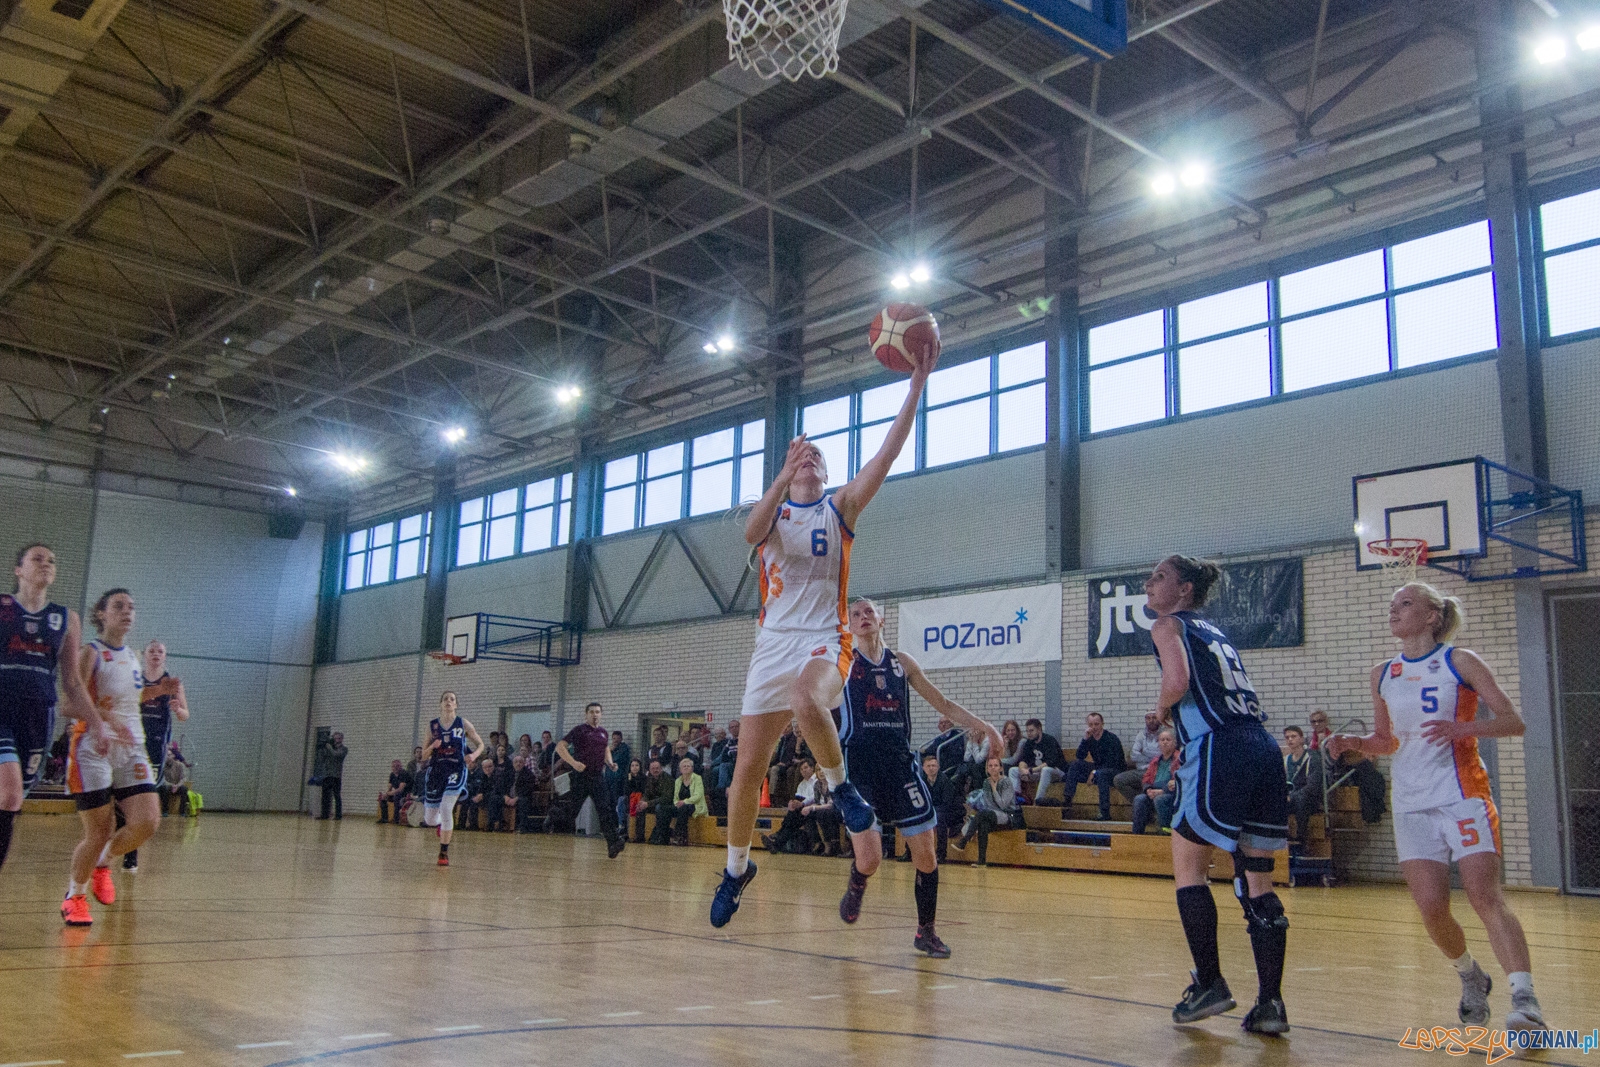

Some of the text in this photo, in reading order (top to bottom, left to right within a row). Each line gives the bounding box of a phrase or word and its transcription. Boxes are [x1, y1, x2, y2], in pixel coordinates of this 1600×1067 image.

[811, 529, 828, 557] 6
[48, 613, 63, 631] 9
[890, 658, 904, 678] 5
[1207, 640, 1256, 693] 13
[1420, 686, 1440, 714] 5
[452, 727, 463, 738] 12
[448, 772, 459, 784] 12
[907, 787, 925, 809] 5
[1457, 818, 1480, 848] 5
